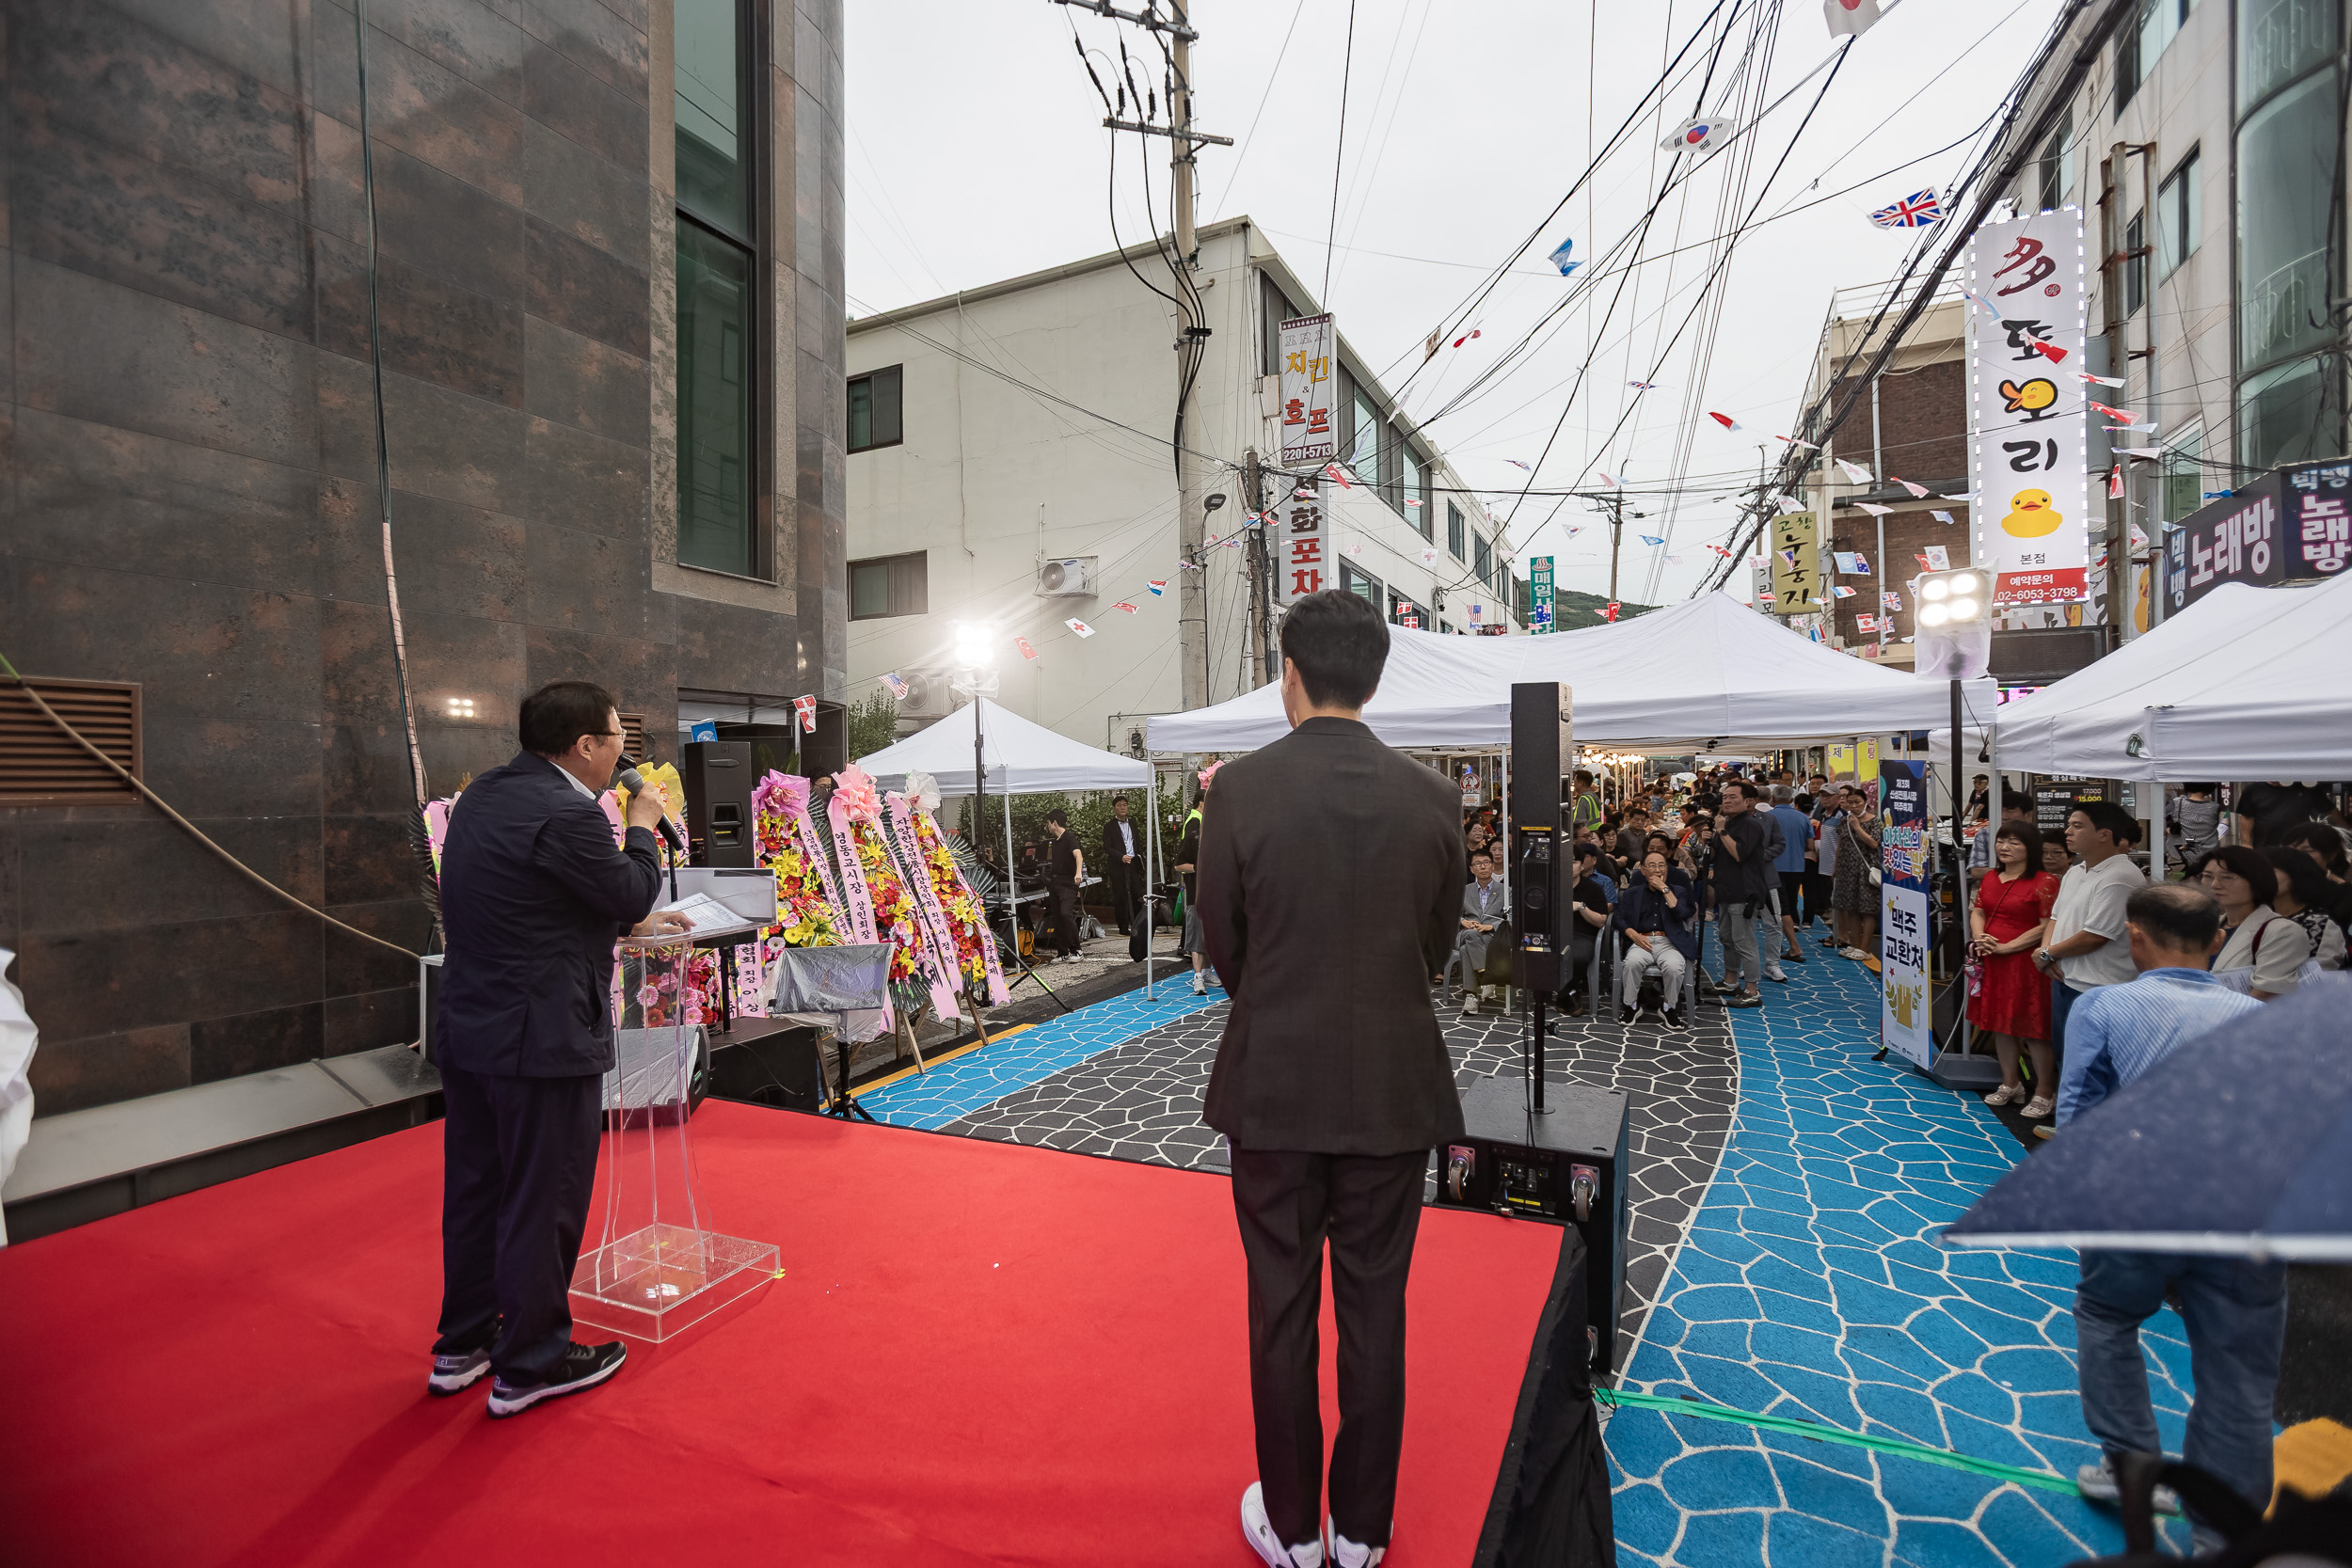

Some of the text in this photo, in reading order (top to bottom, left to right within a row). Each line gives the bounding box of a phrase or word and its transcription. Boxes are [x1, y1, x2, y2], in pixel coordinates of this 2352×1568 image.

[1284, 350, 1328, 384] 치킨
[1284, 399, 1329, 435] 호프
[1284, 444, 1331, 461] 2201-5713
[1778, 516, 1812, 533] 고향
[2190, 495, 2275, 588] 노래방
[2299, 494, 2352, 572] 노래방
[2020, 553, 2045, 564] 본점
[2170, 530, 2185, 609] 빅뱅
[2010, 574, 2054, 586] 예약문의
[835, 832, 871, 940] 영동교시장 상인회장
[1891, 907, 1917, 938] 맥주
[1885, 935, 1924, 972] 교환처
